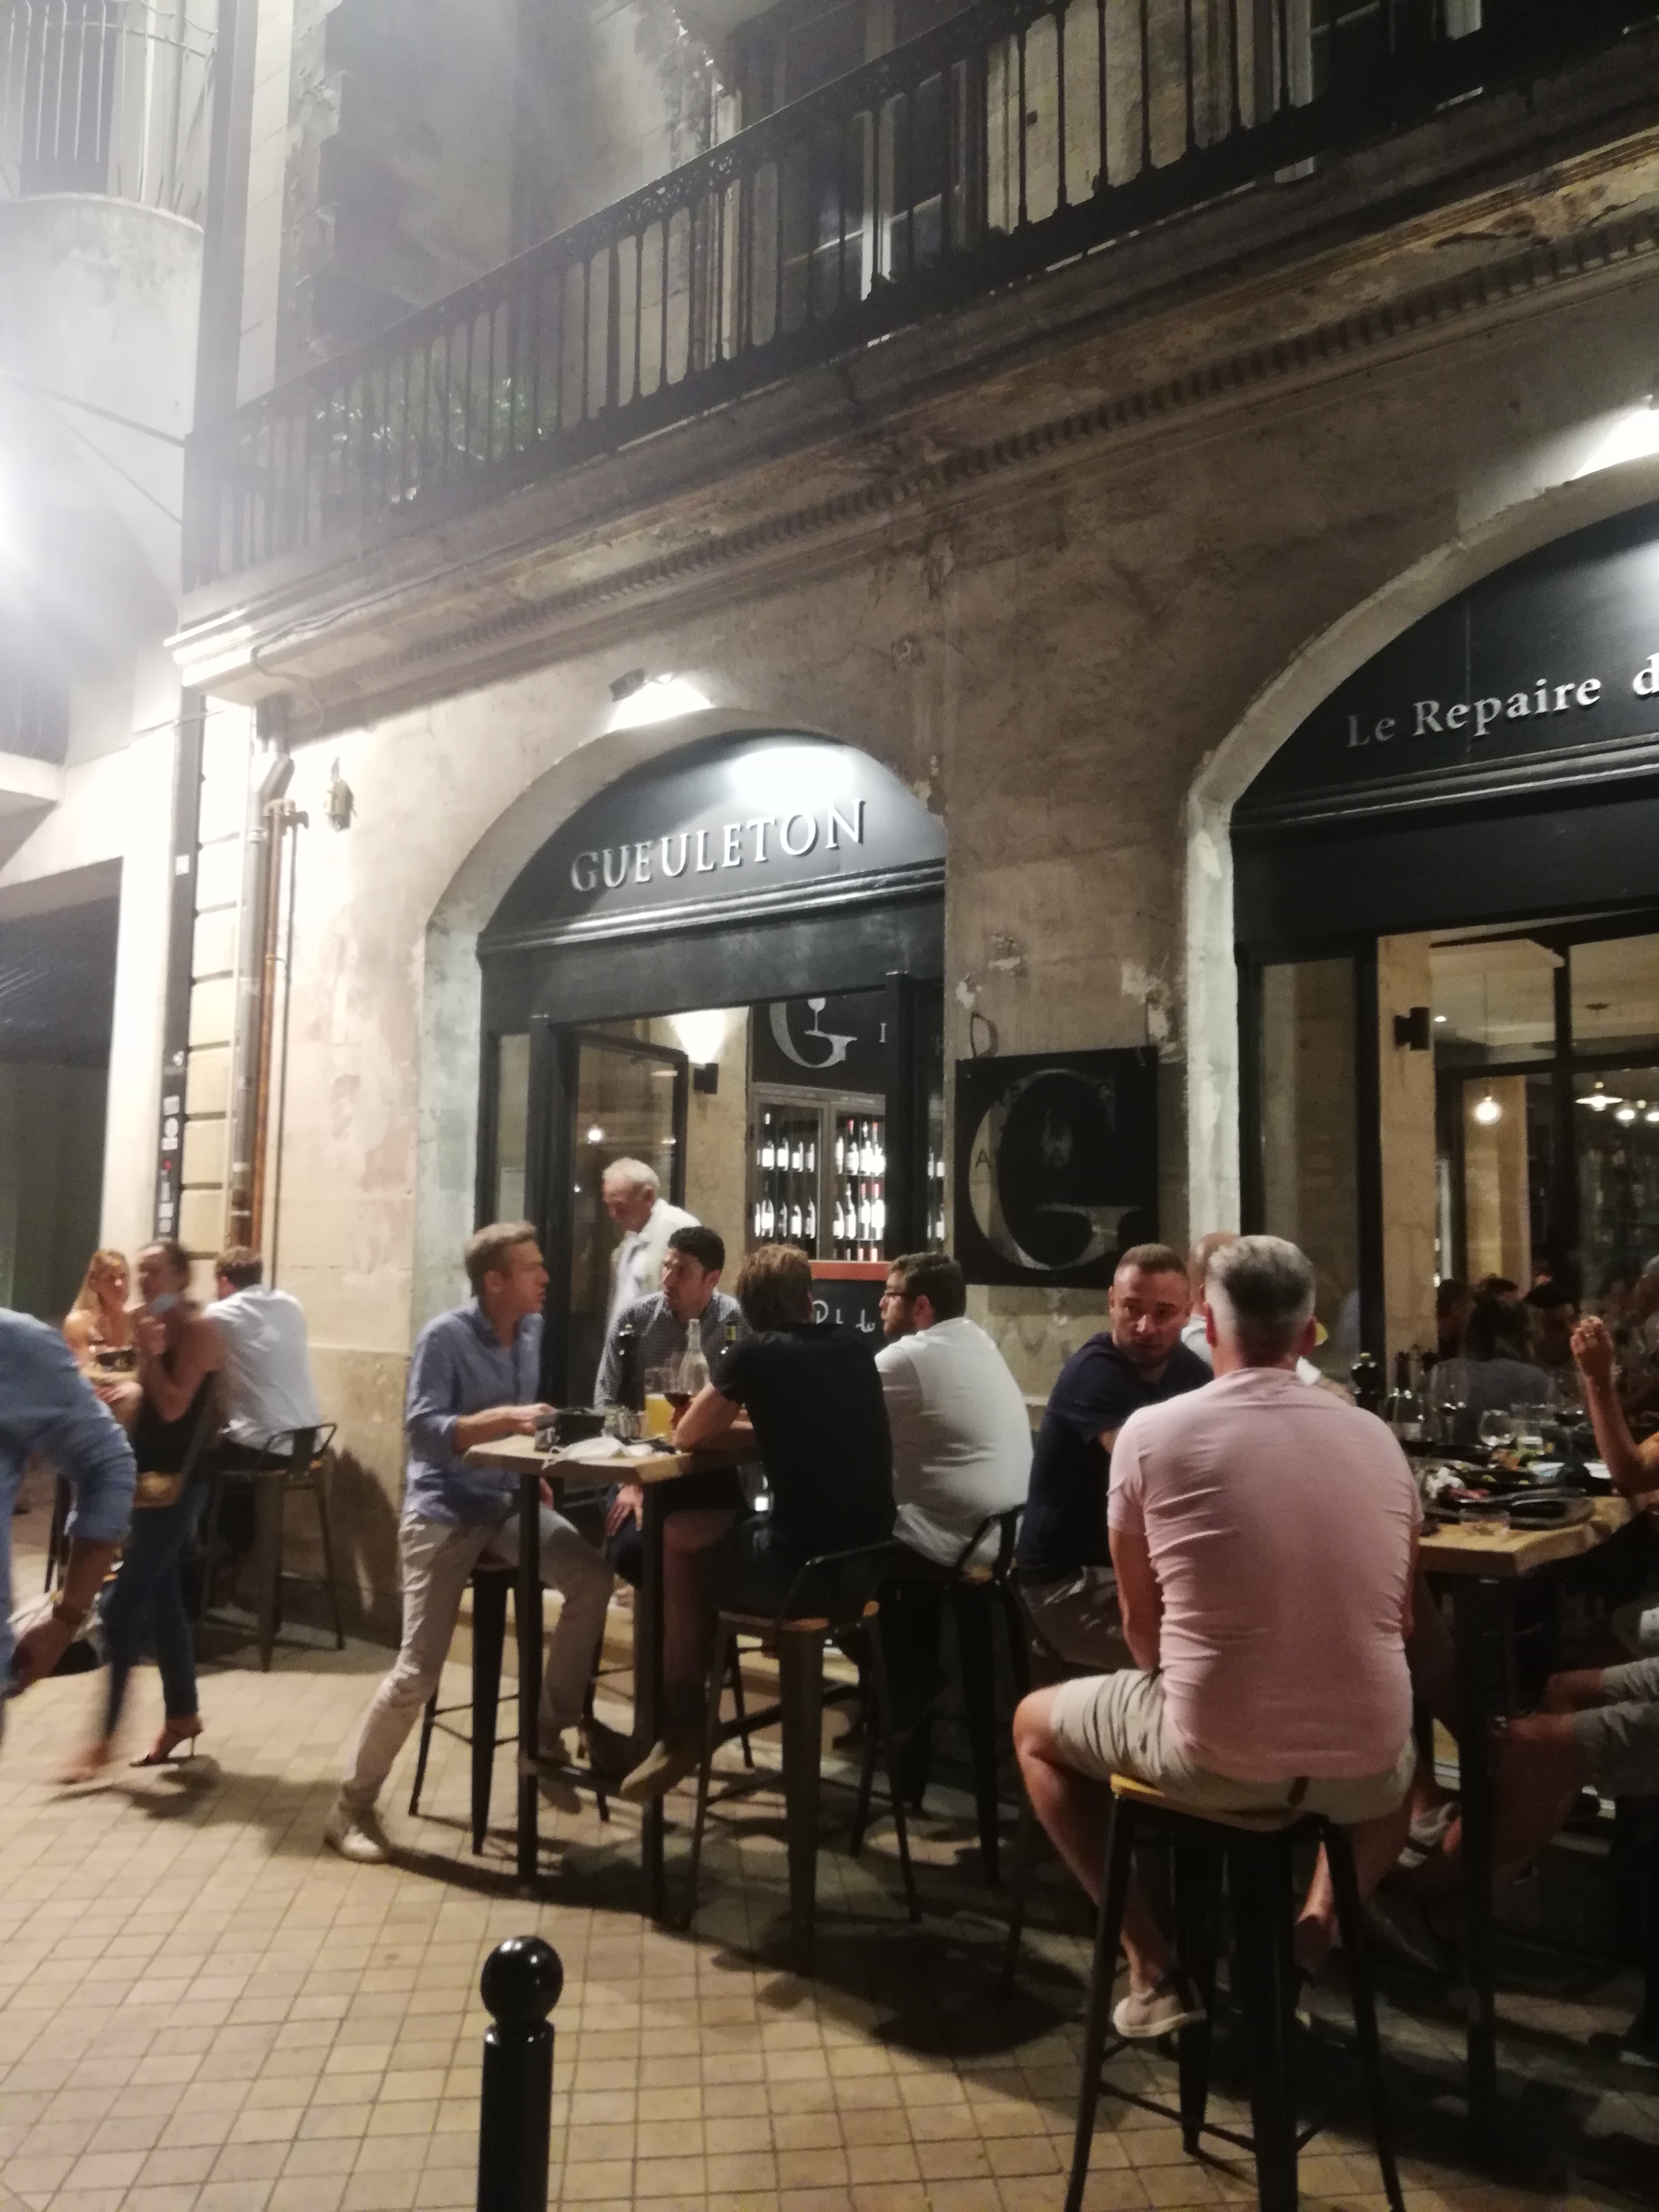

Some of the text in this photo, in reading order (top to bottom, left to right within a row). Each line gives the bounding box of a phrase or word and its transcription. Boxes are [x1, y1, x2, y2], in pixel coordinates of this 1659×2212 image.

[1347, 713, 1395, 748] Le
[1411, 677, 1602, 737] Repaire
[570, 798, 866, 891] GUEULETON
